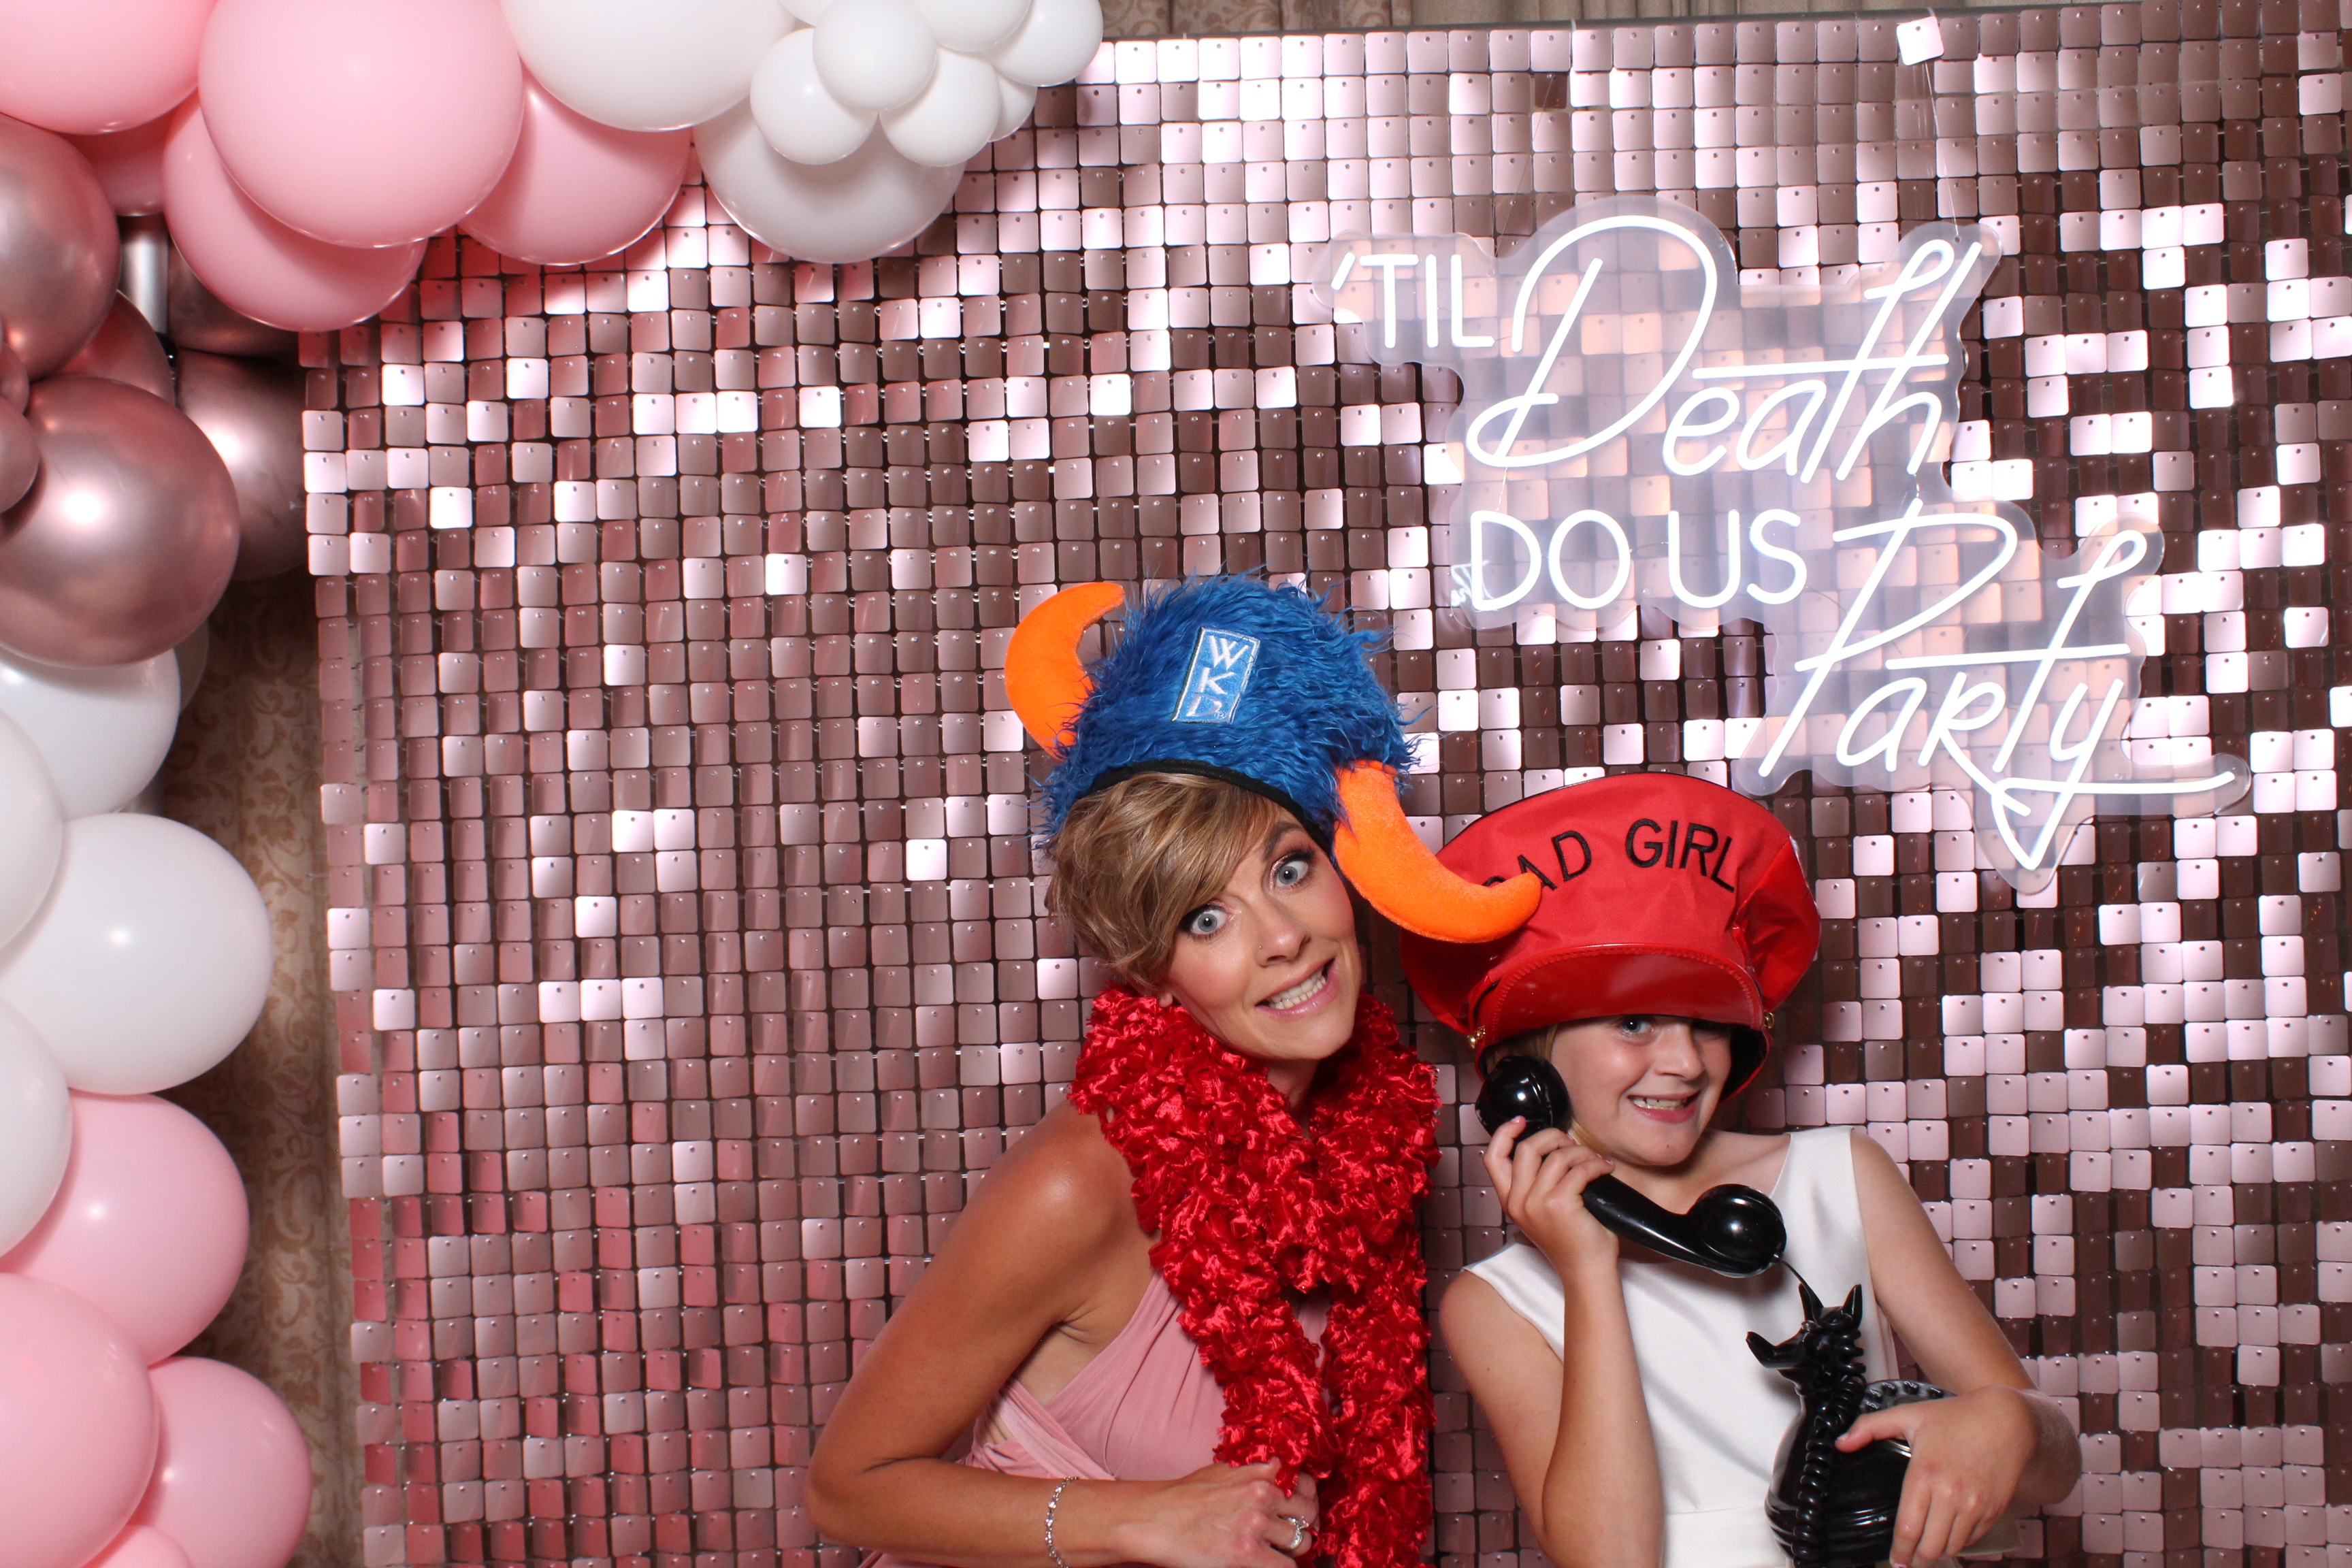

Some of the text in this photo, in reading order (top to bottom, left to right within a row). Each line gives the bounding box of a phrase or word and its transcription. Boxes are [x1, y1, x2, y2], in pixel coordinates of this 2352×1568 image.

[1332, 213, 1982, 484] 'TIL Death
[1469, 510, 1633, 612] DO
[1667, 510, 1808, 608] US
[1186, 635, 1250, 717] WKD
[1483, 817, 1735, 893] AD GIRL
